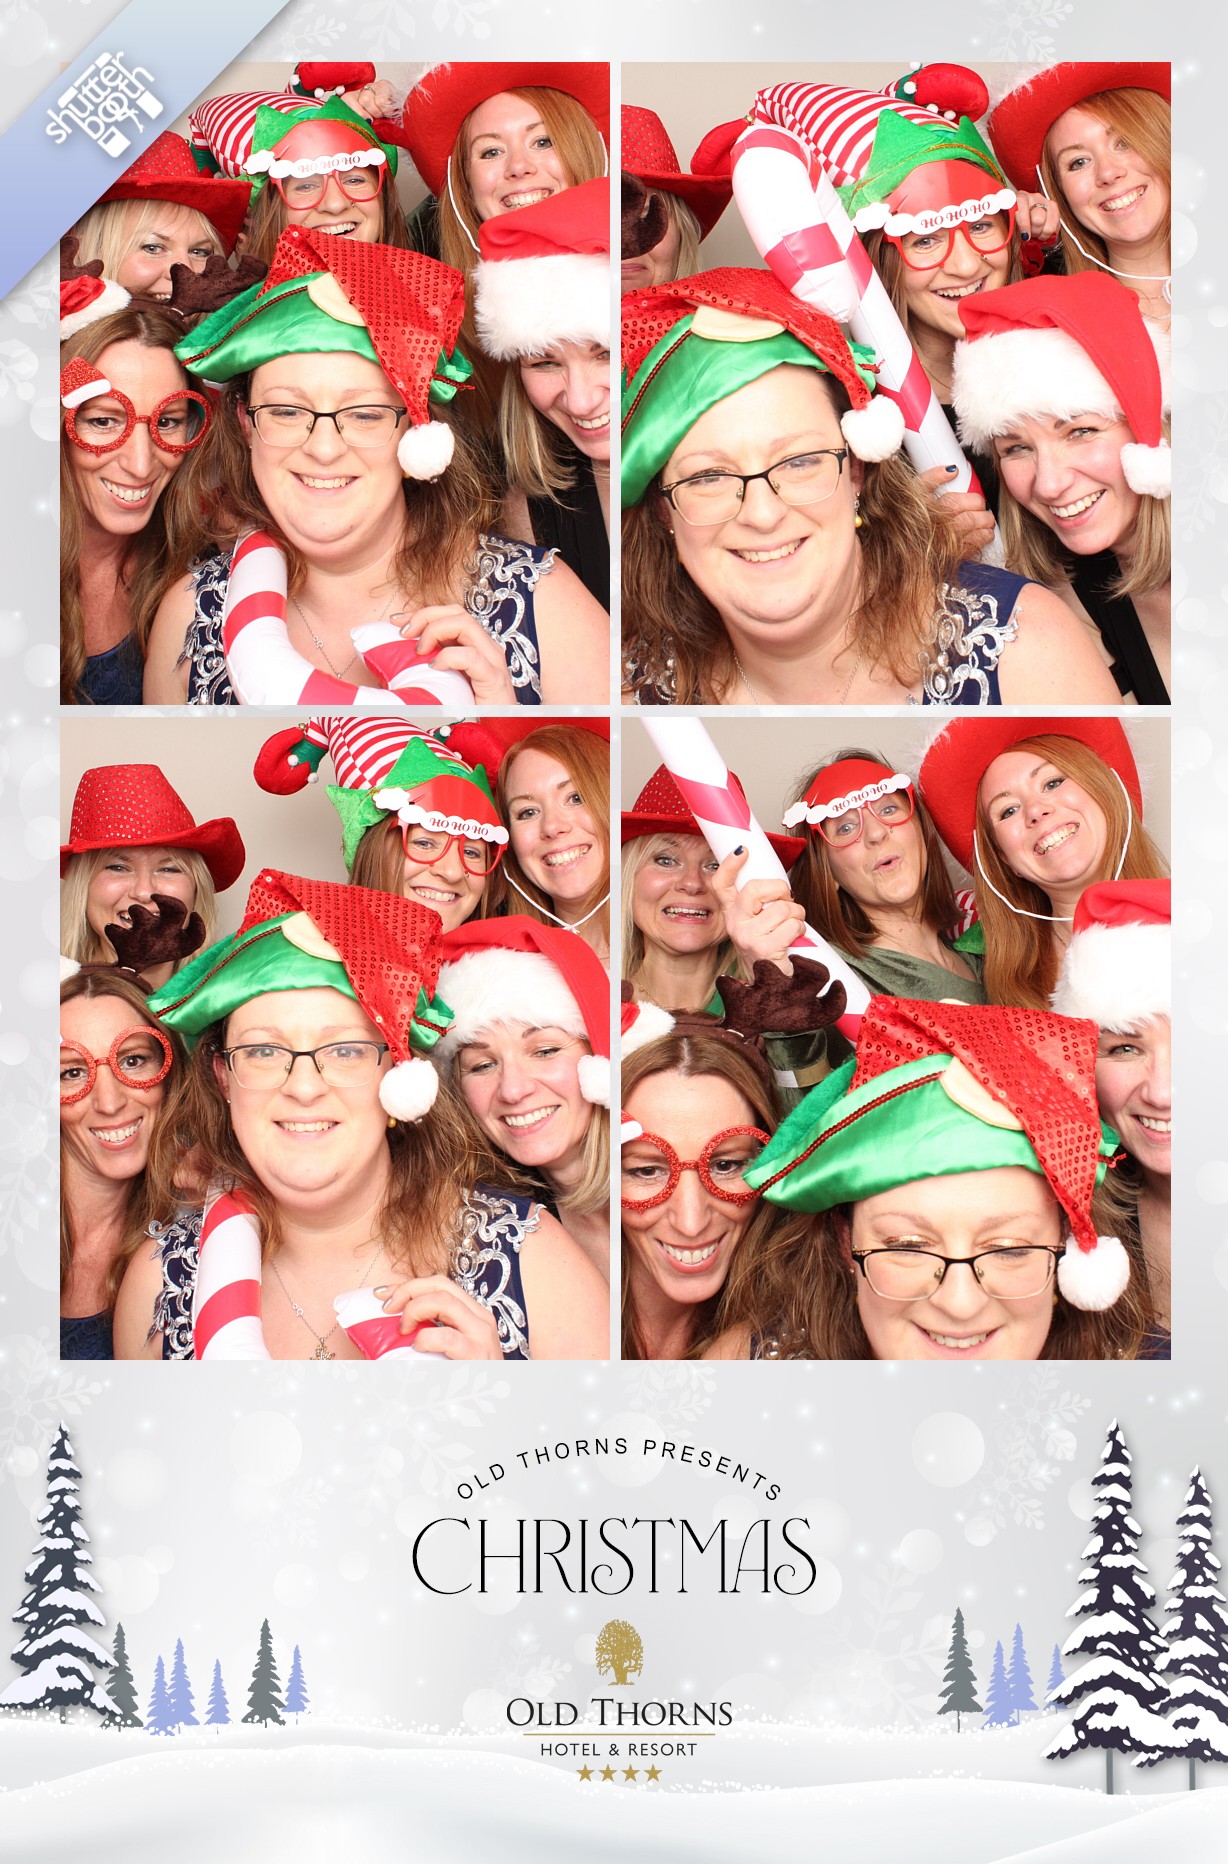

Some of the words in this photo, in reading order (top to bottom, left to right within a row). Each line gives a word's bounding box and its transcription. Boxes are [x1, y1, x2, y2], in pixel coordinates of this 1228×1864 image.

[298, 163, 319, 174] HO
[319, 158, 340, 171] HO
[341, 155, 361, 166] HO
[920, 216, 944, 228] HO
[945, 208, 968, 222] HO
[969, 201, 991, 214] HO
[832, 799, 850, 812] HO
[851, 791, 870, 803] HO
[870, 783, 888, 795] HO
[429, 817, 450, 828] HO
[451, 821, 470, 832] HO
[471, 825, 489, 836] HO
